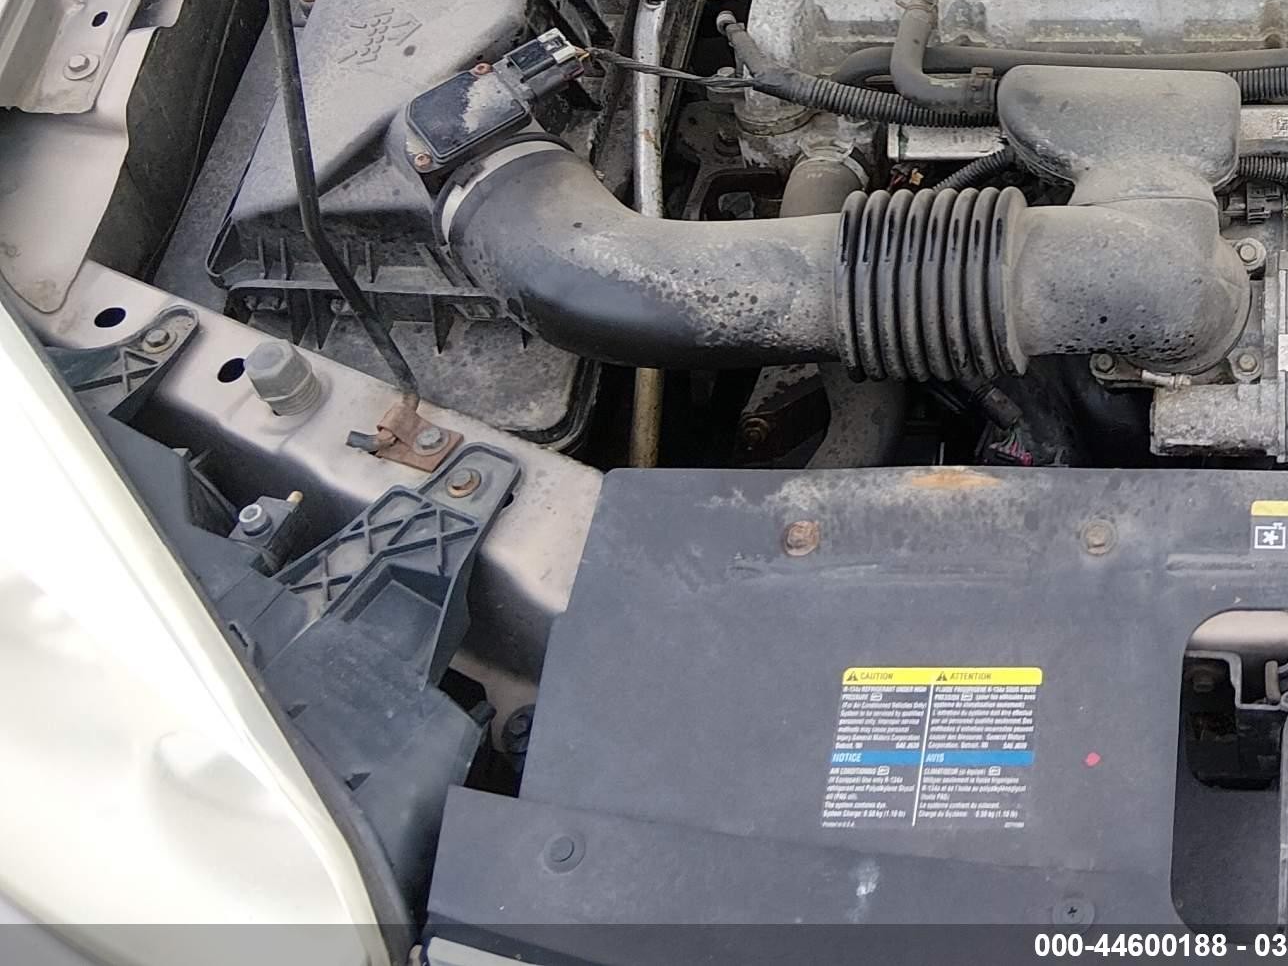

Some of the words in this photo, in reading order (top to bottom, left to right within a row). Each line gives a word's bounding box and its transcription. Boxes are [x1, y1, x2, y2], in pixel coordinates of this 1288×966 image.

[860, 672, 894, 680] CAUTION
[950, 672, 991, 680] ATTENTION
[832, 753, 862, 763] NOTICE
[925, 753, 945, 763] AVIS
